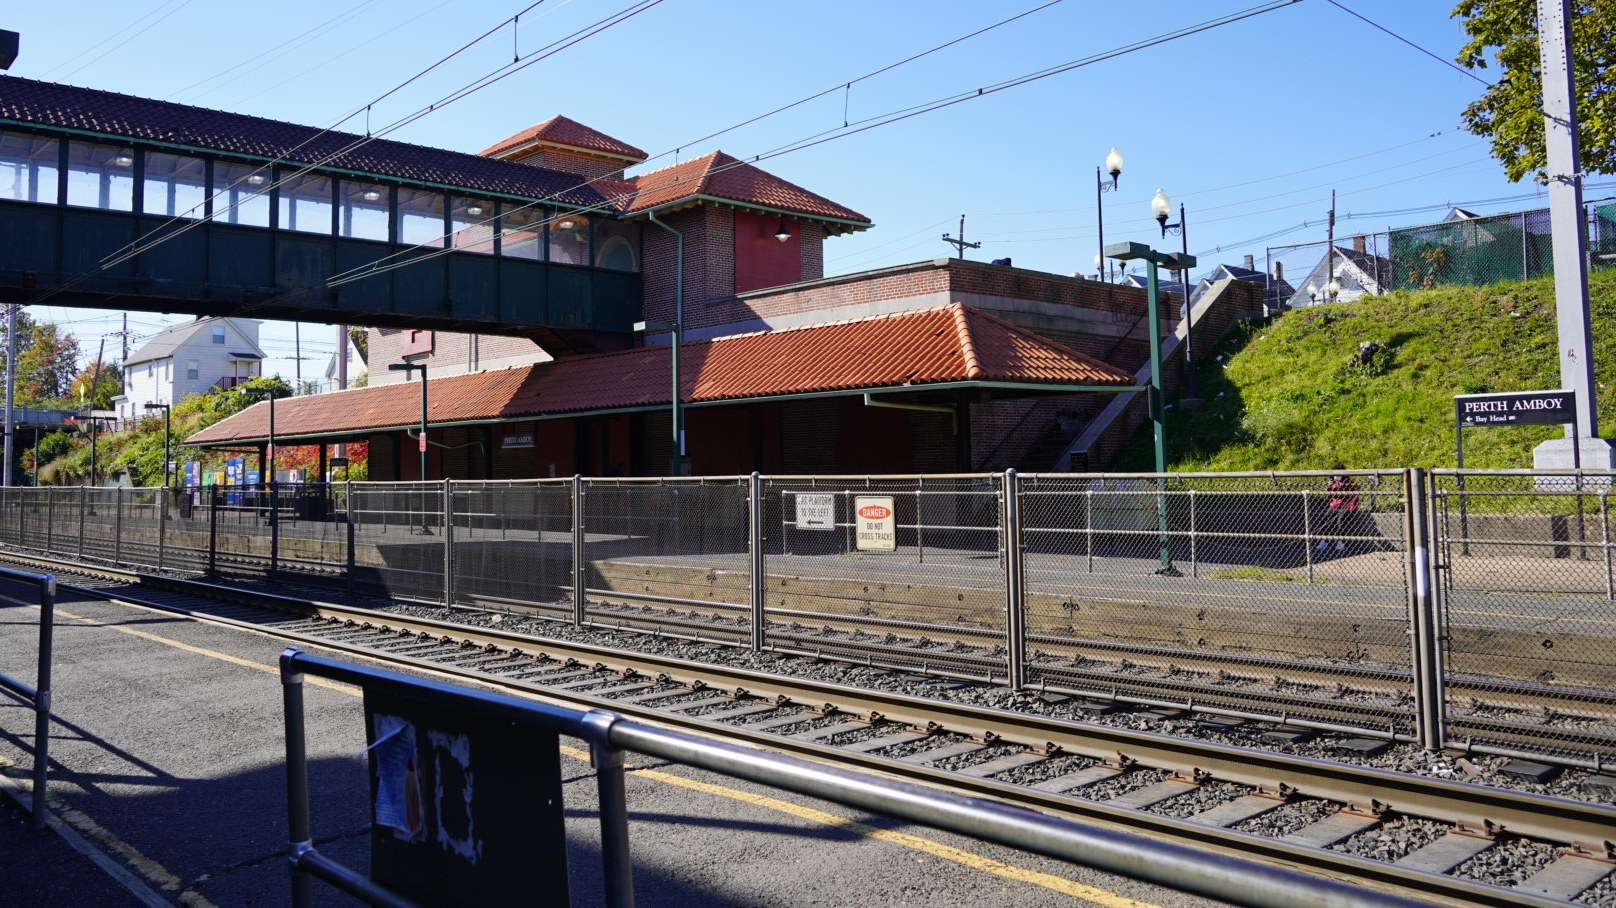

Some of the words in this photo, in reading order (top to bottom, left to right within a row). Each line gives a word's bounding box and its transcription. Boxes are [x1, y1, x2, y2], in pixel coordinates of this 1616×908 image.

[1464, 401, 1508, 413] PERTH
[1512, 398, 1564, 411] AMBOY
[1475, 415, 1488, 423] Bay
[862, 507, 887, 517] DANGER
[874, 522, 884, 530] NOT
[874, 533, 893, 541] TRACKS
